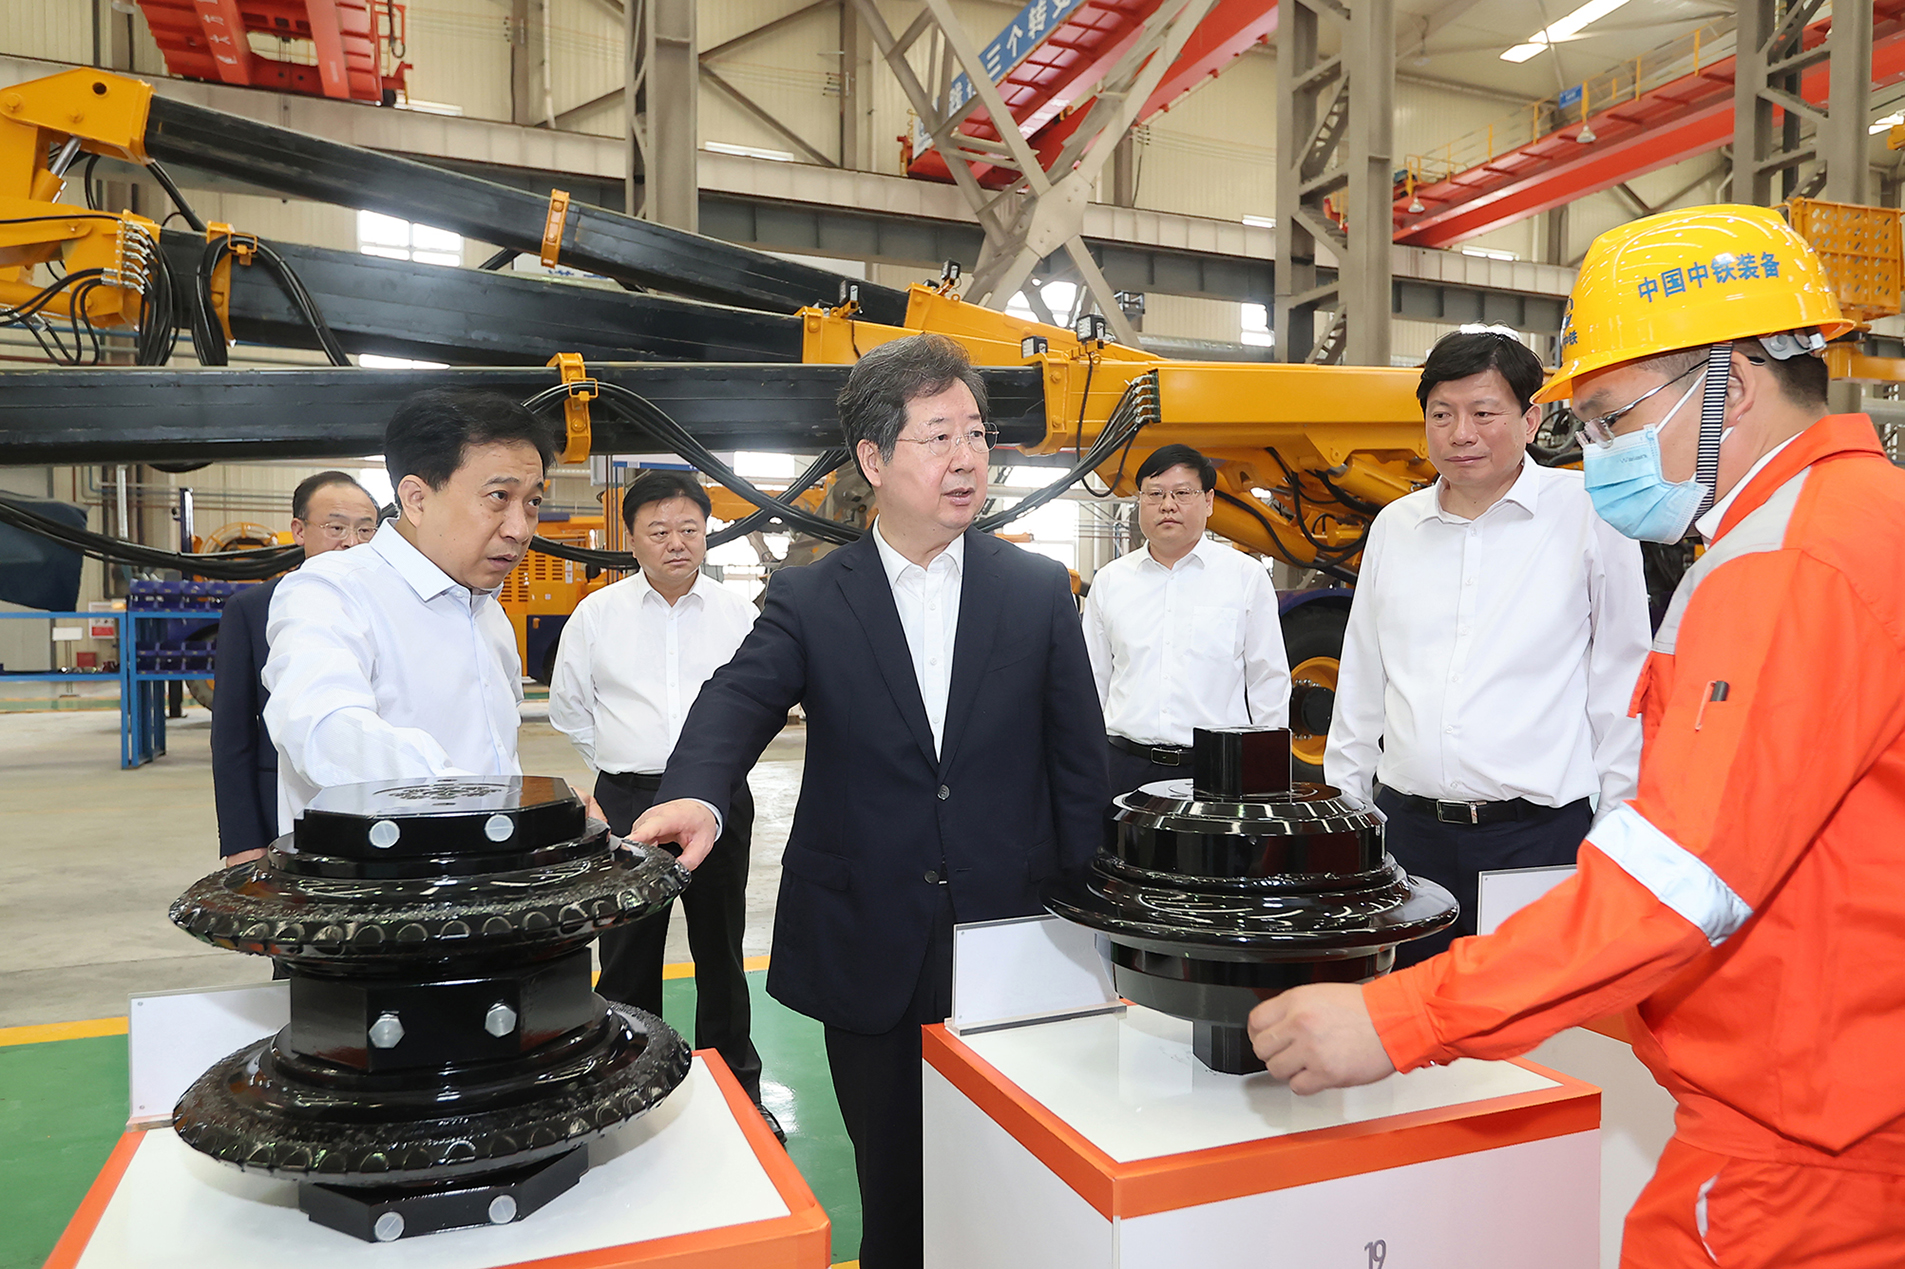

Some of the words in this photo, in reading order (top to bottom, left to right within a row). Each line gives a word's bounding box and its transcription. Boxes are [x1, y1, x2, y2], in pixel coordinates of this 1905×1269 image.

[1638, 251, 1780, 303] 中国中铁装备
